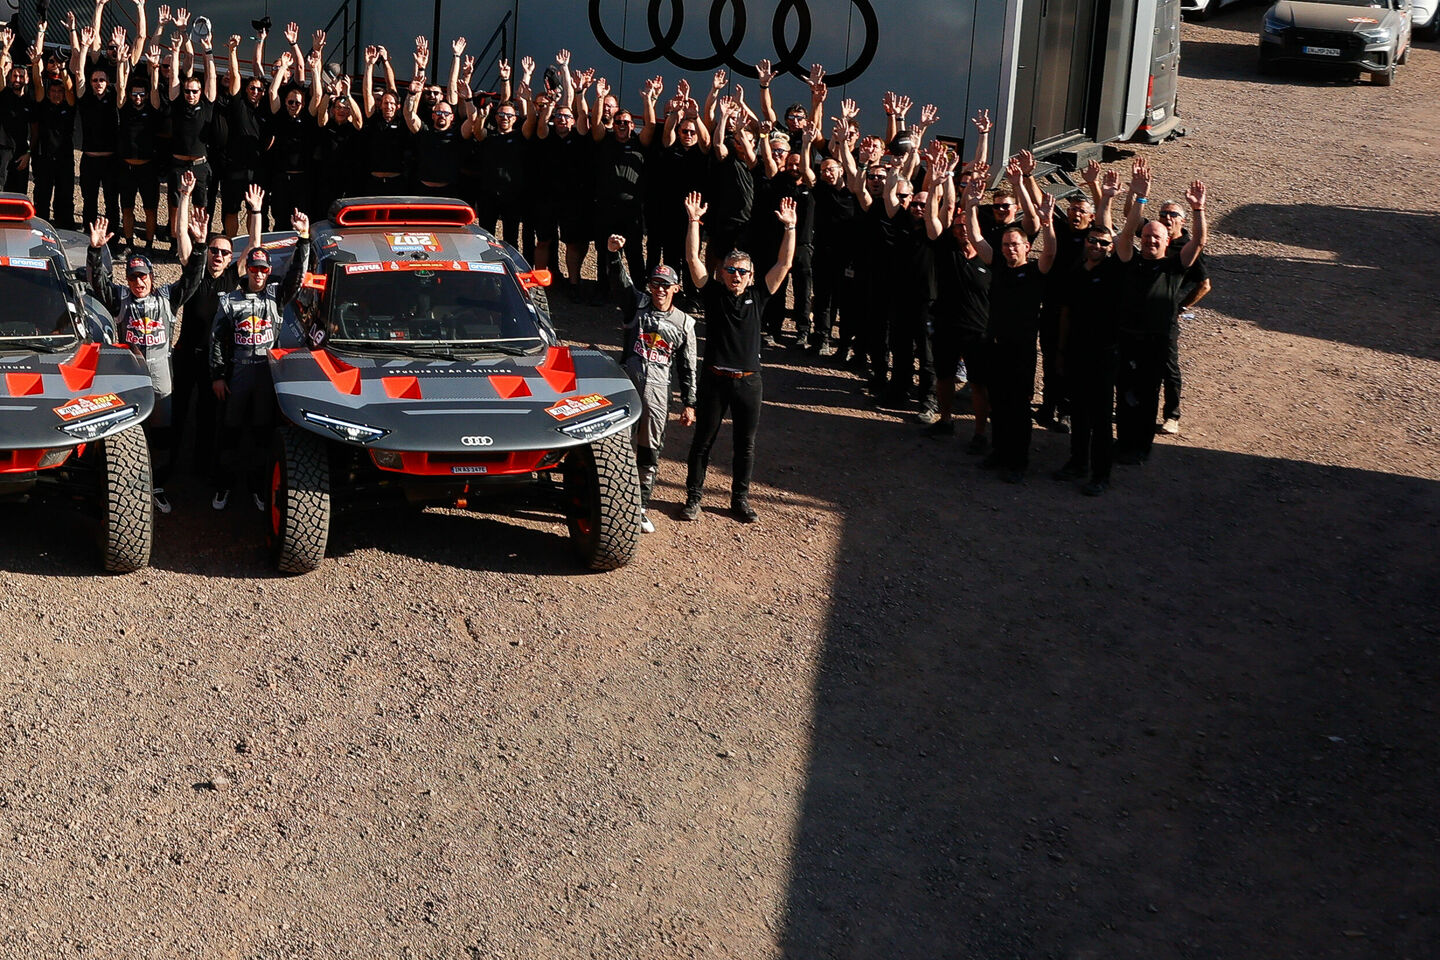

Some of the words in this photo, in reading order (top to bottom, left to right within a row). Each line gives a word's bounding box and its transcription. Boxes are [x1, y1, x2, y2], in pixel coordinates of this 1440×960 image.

[394, 235, 433, 245] 207
[11, 259, 44, 267] aramco
[348, 264, 381, 272] MOTUL
[469, 264, 503, 273] aramco
[125, 330, 147, 345] Red
[147, 331, 167, 345] Bull
[234, 332, 255, 345] Red
[254, 330, 274, 346] Bull
[92, 394, 116, 404] 2024
[580, 394, 603, 404] 2024
